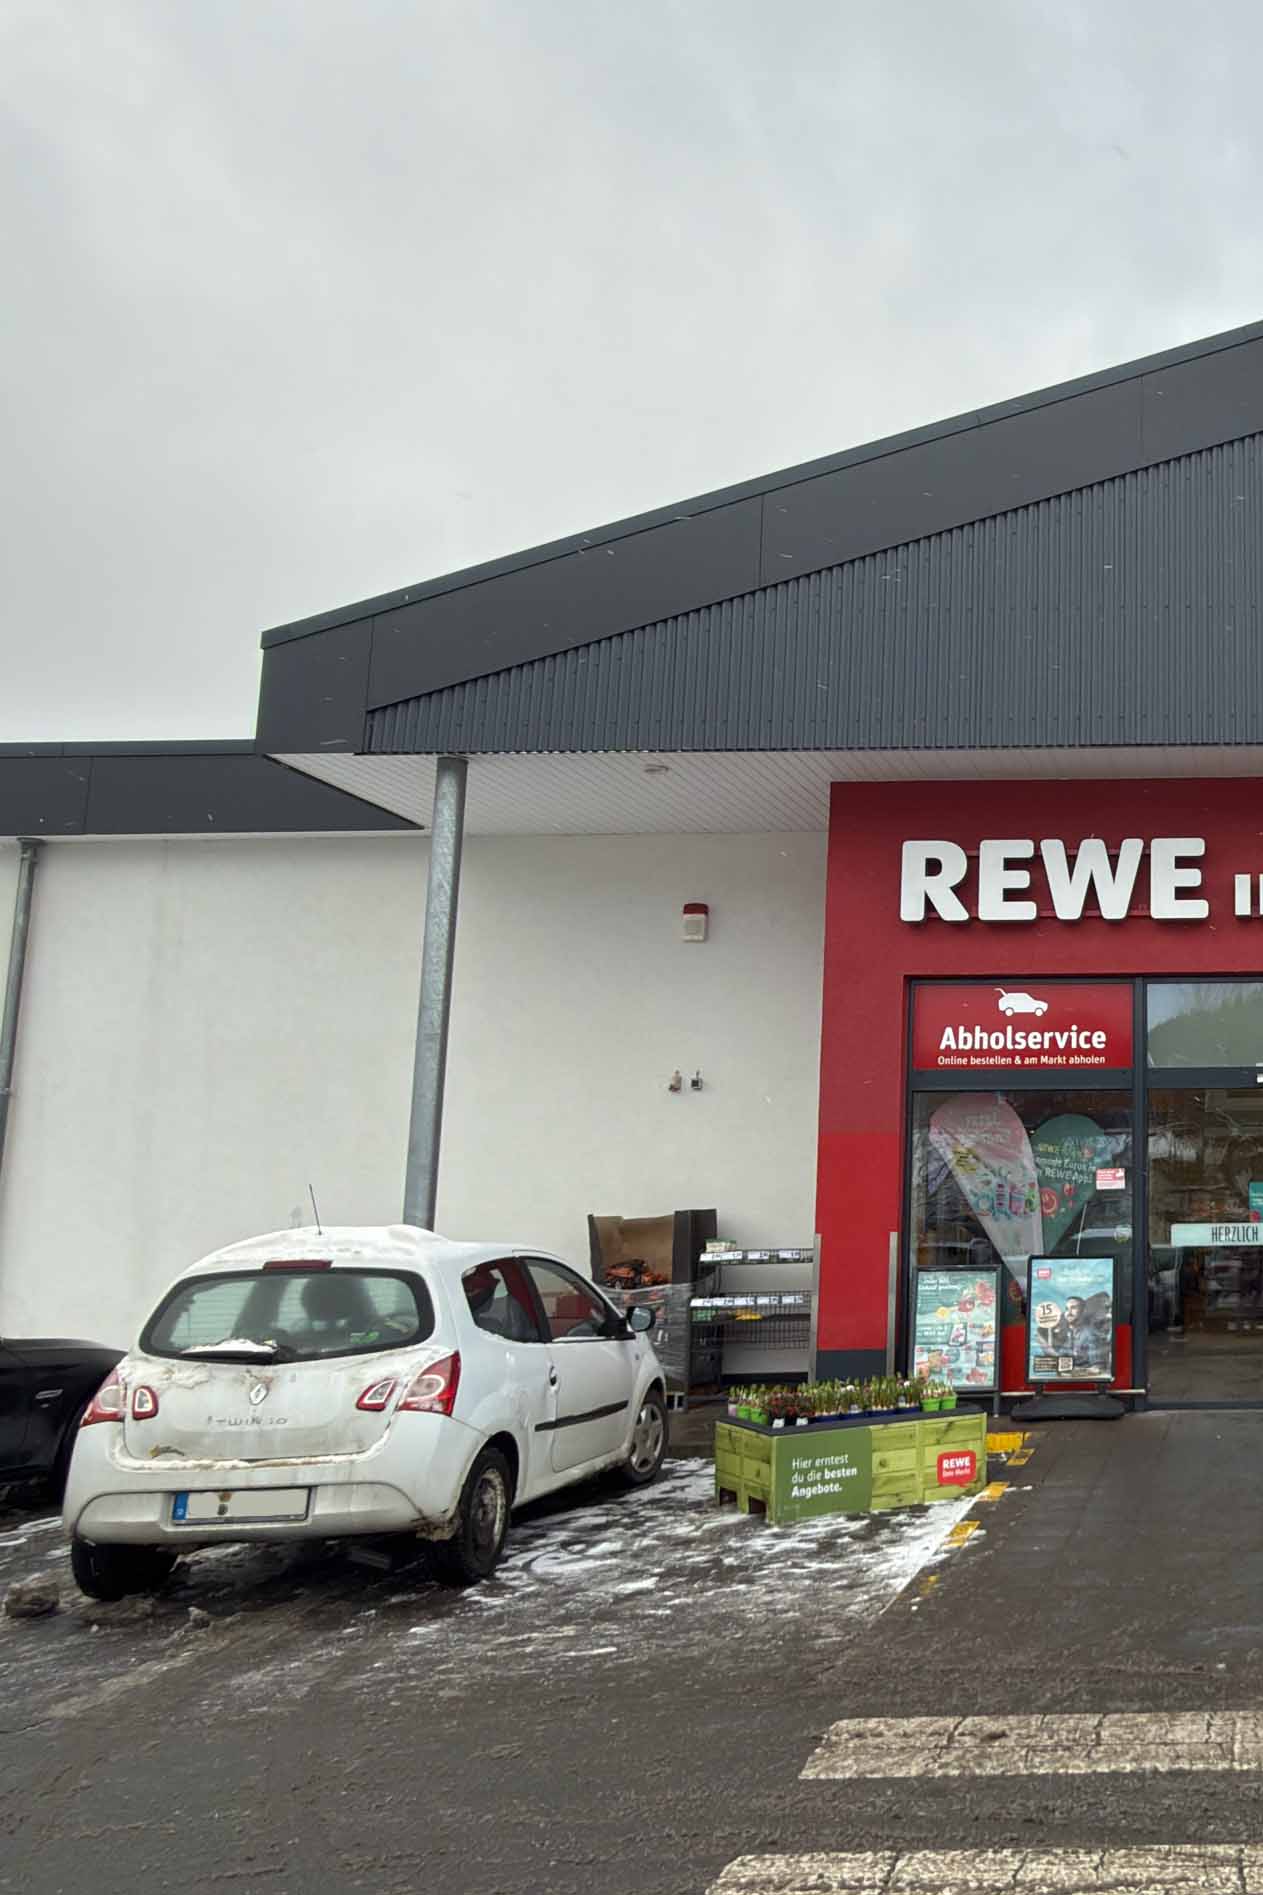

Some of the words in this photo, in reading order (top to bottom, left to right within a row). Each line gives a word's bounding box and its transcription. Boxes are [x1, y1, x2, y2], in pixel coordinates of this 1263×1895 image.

[900, 838, 1209, 922] REWE
[939, 1024, 1107, 1050] Abholservice
[937, 1055, 968, 1066] Online
[970, 1055, 1012, 1065] bestellen
[1014, 1055, 1021, 1065] &
[1024, 1056, 1038, 1065] am
[1040, 1055, 1067, 1064] Markt
[1068, 1055, 1106, 1065] abholen
[1211, 1226, 1259, 1243] HERZLICH
[1040, 1303, 1053, 1316] 15
[791, 1457, 812, 1470] Hier
[814, 1454, 849, 1467] erntest
[942, 1456, 971, 1470] REWE
[791, 1472, 804, 1484] du
[807, 1470, 822, 1481] die
[823, 1467, 857, 1480] besten
[791, 1483, 843, 1499] Angebote.
